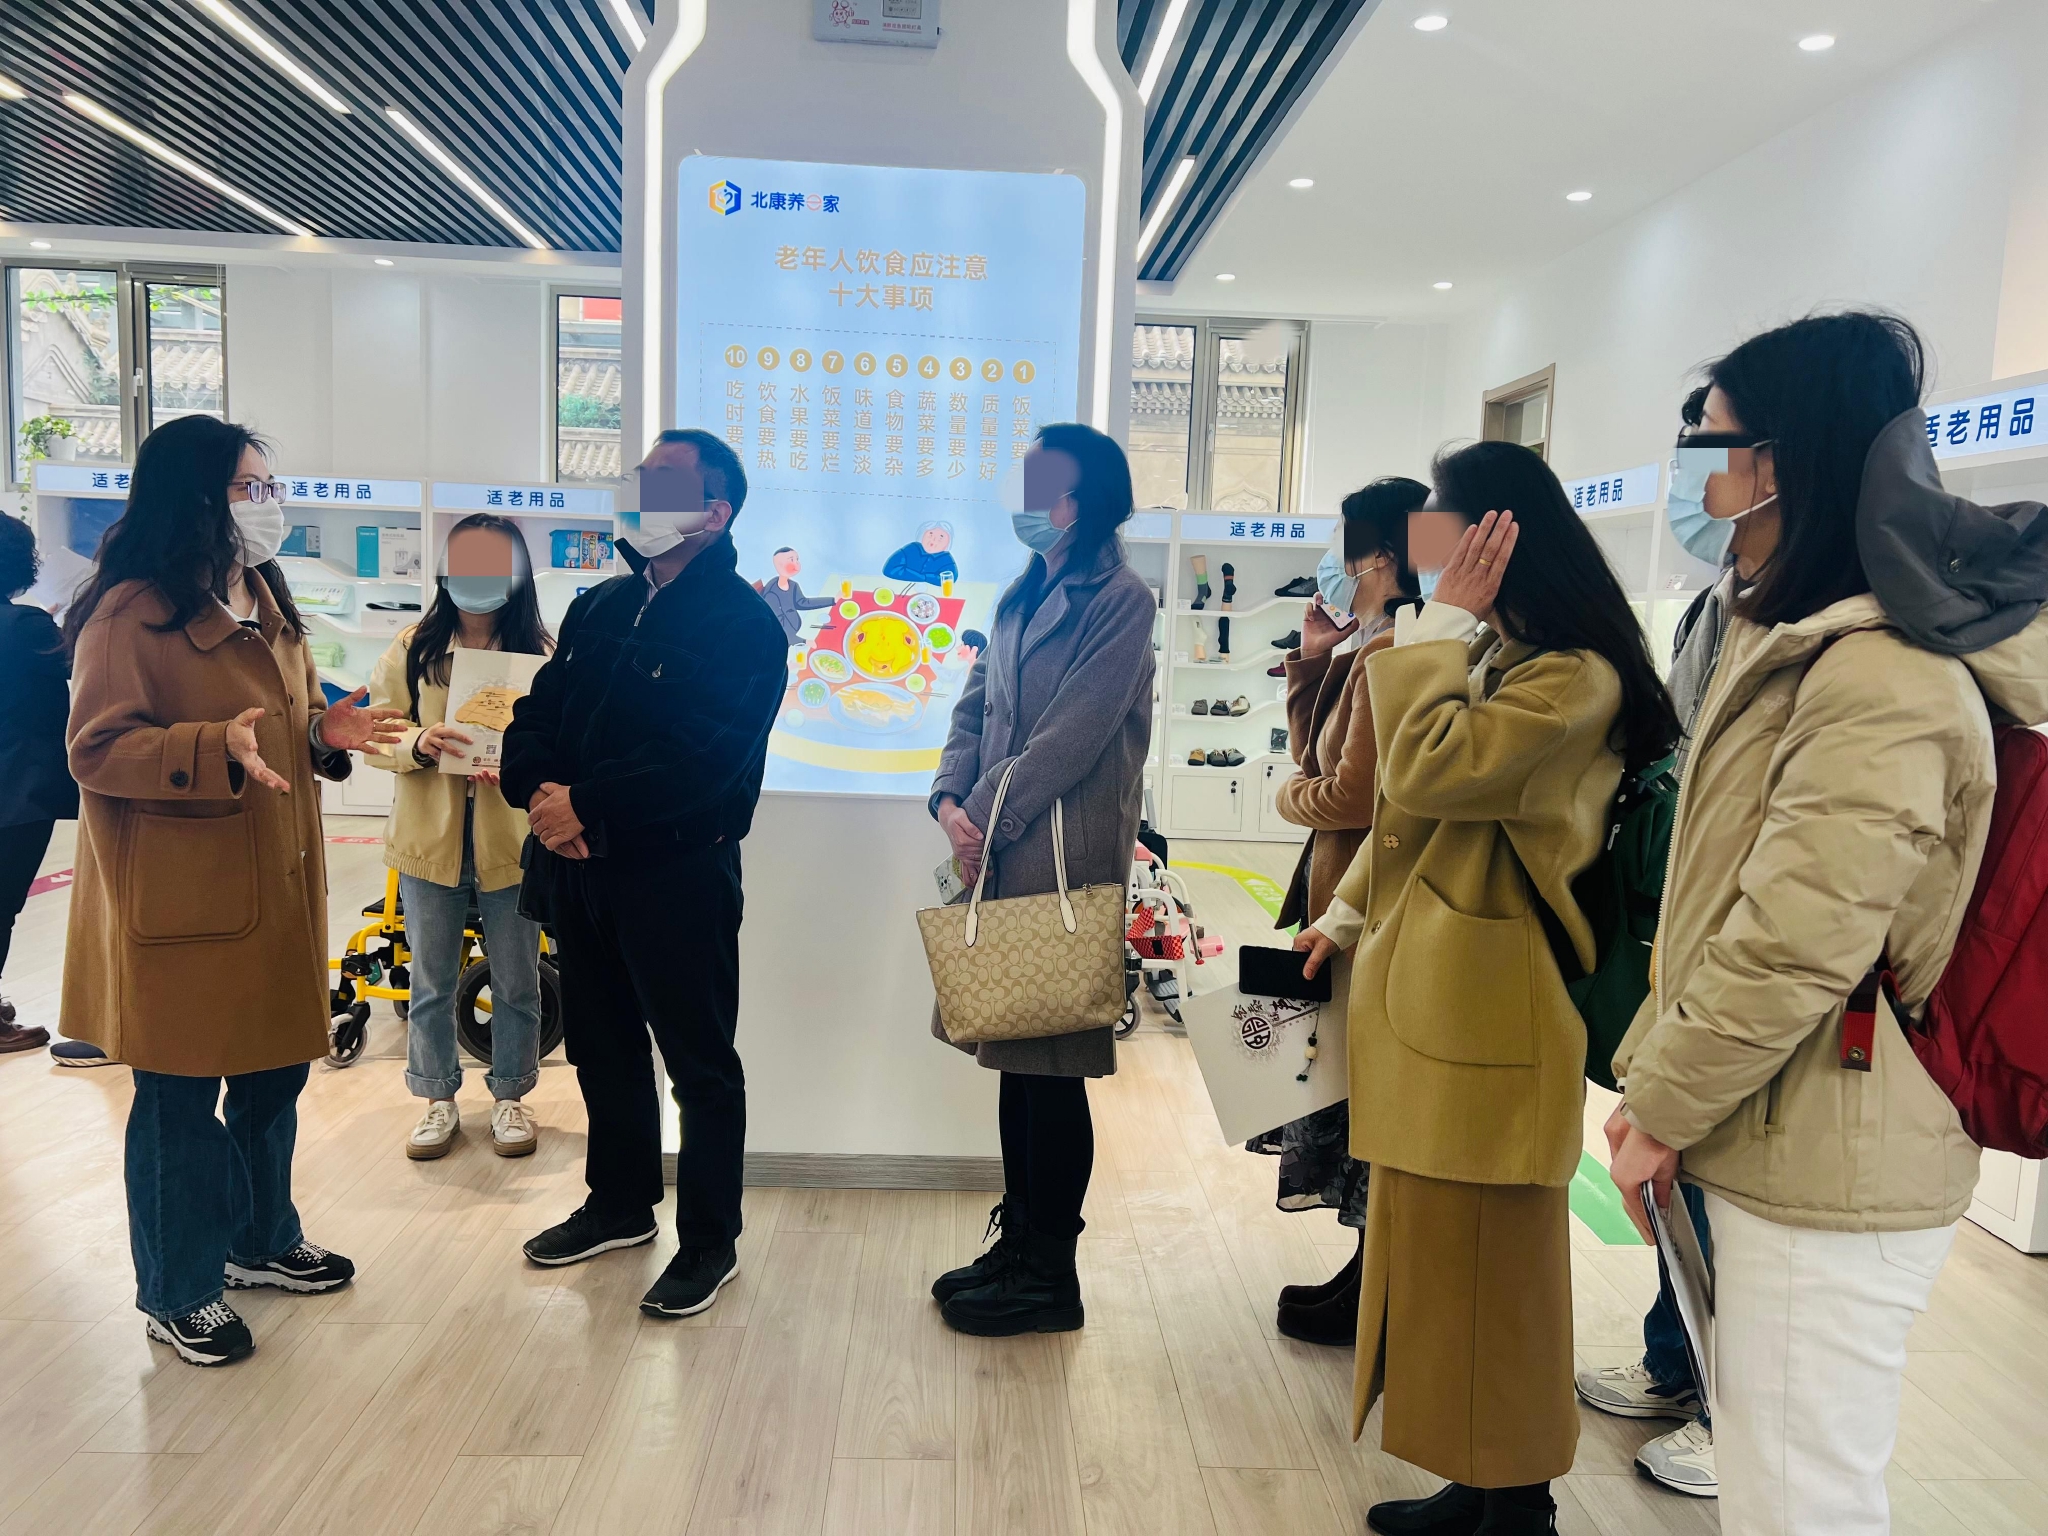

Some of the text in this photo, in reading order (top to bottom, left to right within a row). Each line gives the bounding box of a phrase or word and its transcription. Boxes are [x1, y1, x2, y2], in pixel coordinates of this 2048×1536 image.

[774, 244, 988, 281] 老年人饮食应注意
[828, 281, 934, 312] 十大事项
[757, 381, 777, 470] 饮食要热
[789, 383, 810, 471] 水果要吃
[821, 385, 841, 473] 饭菜要烂
[853, 387, 873, 475] 味道要淡
[885, 389, 905, 477] 食物要杂
[916, 390, 936, 478] 蔬菜要多
[947, 392, 968, 479] 数量要少
[978, 394, 999, 481] 质量要好
[1011, 395, 1031, 470] 饭菜要
[291, 481, 372, 499] 适老用品
[486, 489, 565, 508] 适老用品
[1229, 521, 1306, 539] 适老用品
[1573, 477, 1623, 509] 适老用品
